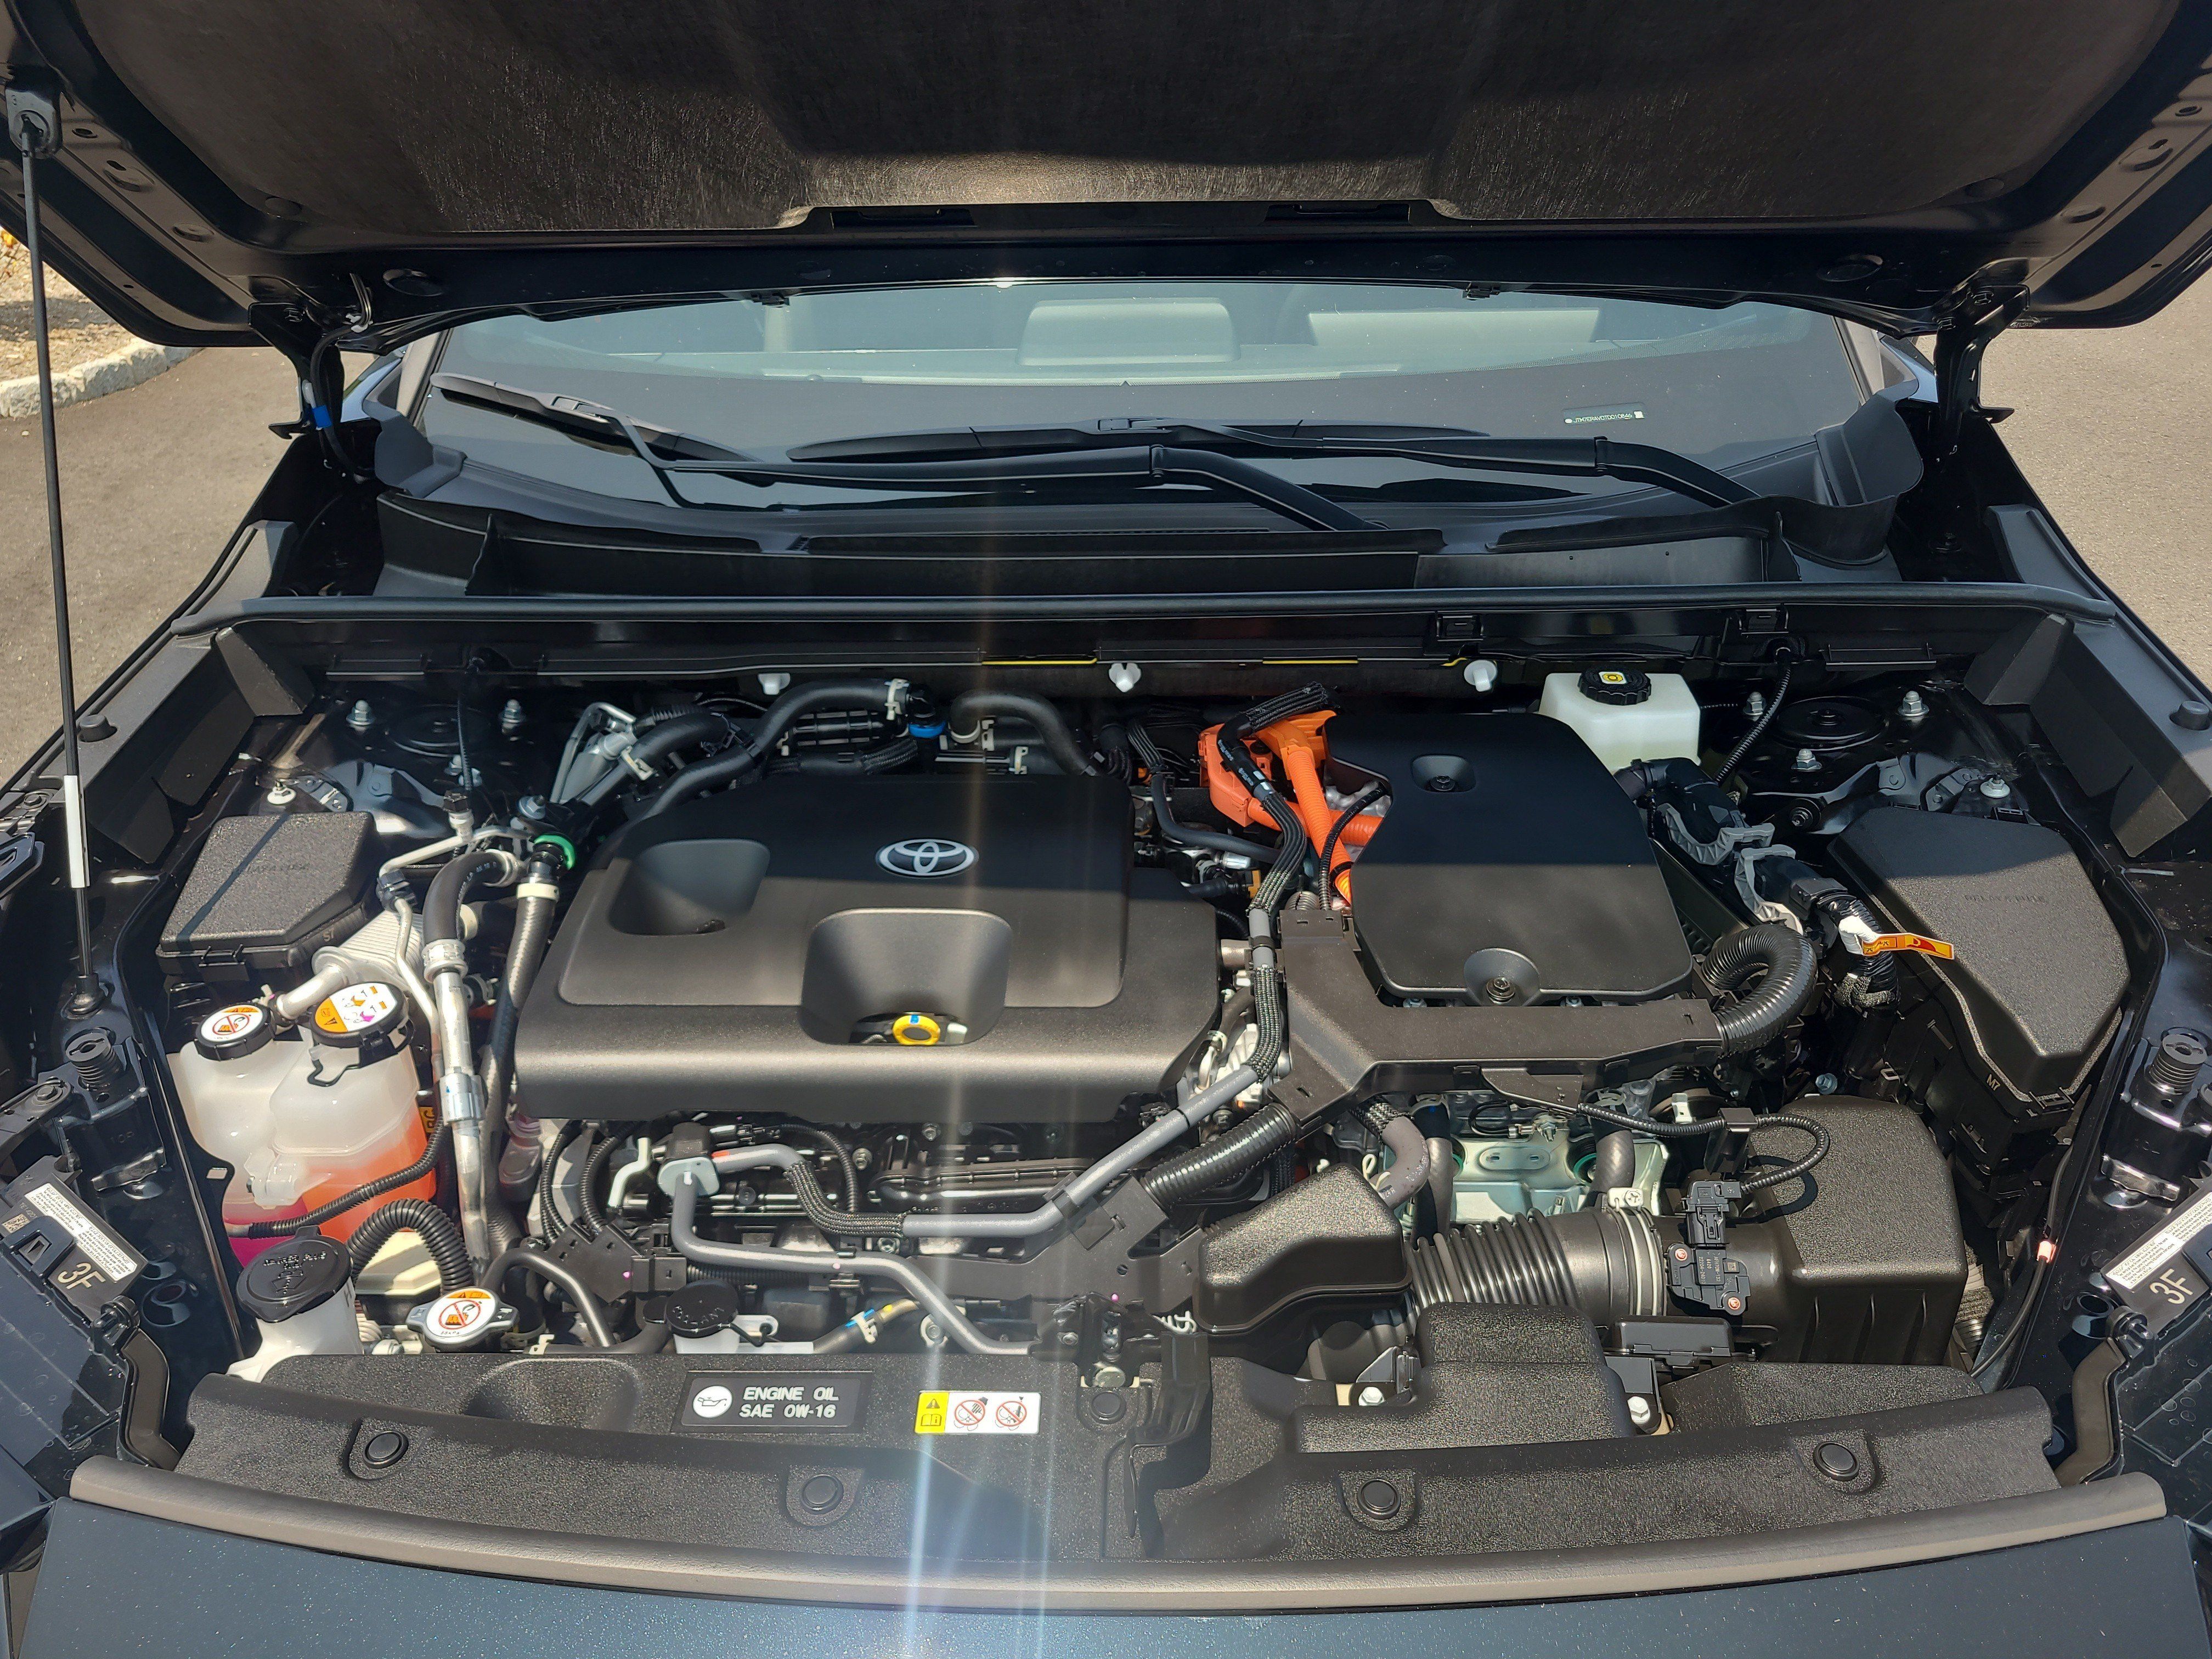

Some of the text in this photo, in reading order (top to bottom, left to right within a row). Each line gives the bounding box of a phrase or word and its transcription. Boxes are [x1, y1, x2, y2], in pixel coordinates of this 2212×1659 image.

[1987, 1074, 2001, 1091] M7
[58, 1262, 106, 1290] 3F
[2150, 1268, 2193, 1304] 3F
[743, 1386, 839, 1401] ENGINE OIL
[739, 1403, 837, 1419] SAE 0W-16
